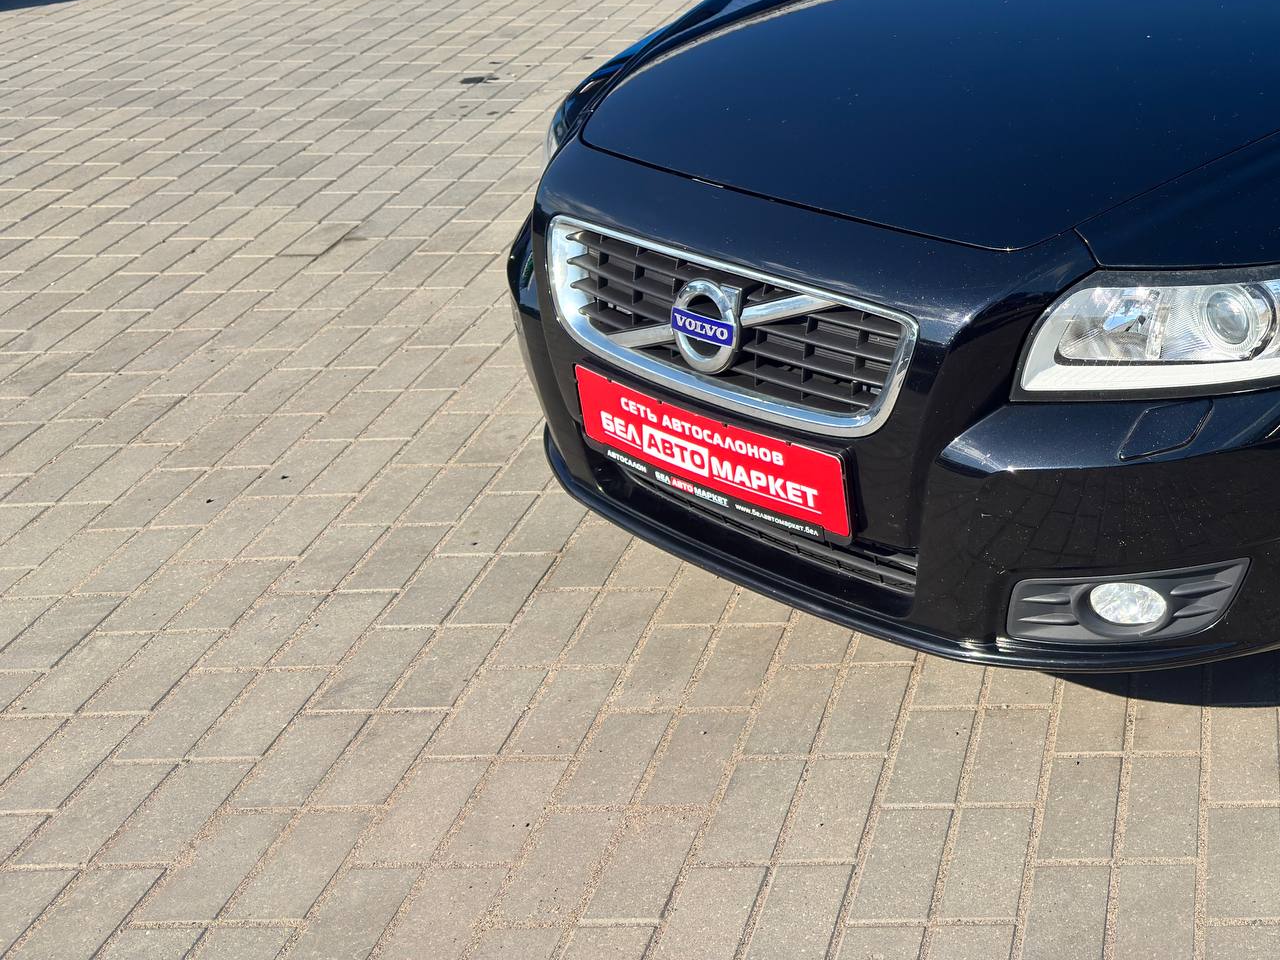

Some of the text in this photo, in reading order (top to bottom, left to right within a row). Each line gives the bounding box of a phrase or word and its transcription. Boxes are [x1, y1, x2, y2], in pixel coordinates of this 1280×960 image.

[674, 312, 729, 341] VOLVO
[600, 410, 818, 508] БЕЛ АВТО МАРКЕТ
[620, 396, 785, 466] СЕТЬ АВТОСАЛОНОВ
[607, 449, 647, 473] АВТОСАЛОН
[655, 471, 671, 486] БЕЛ
[693, 486, 729, 506] МАРКЕТ
